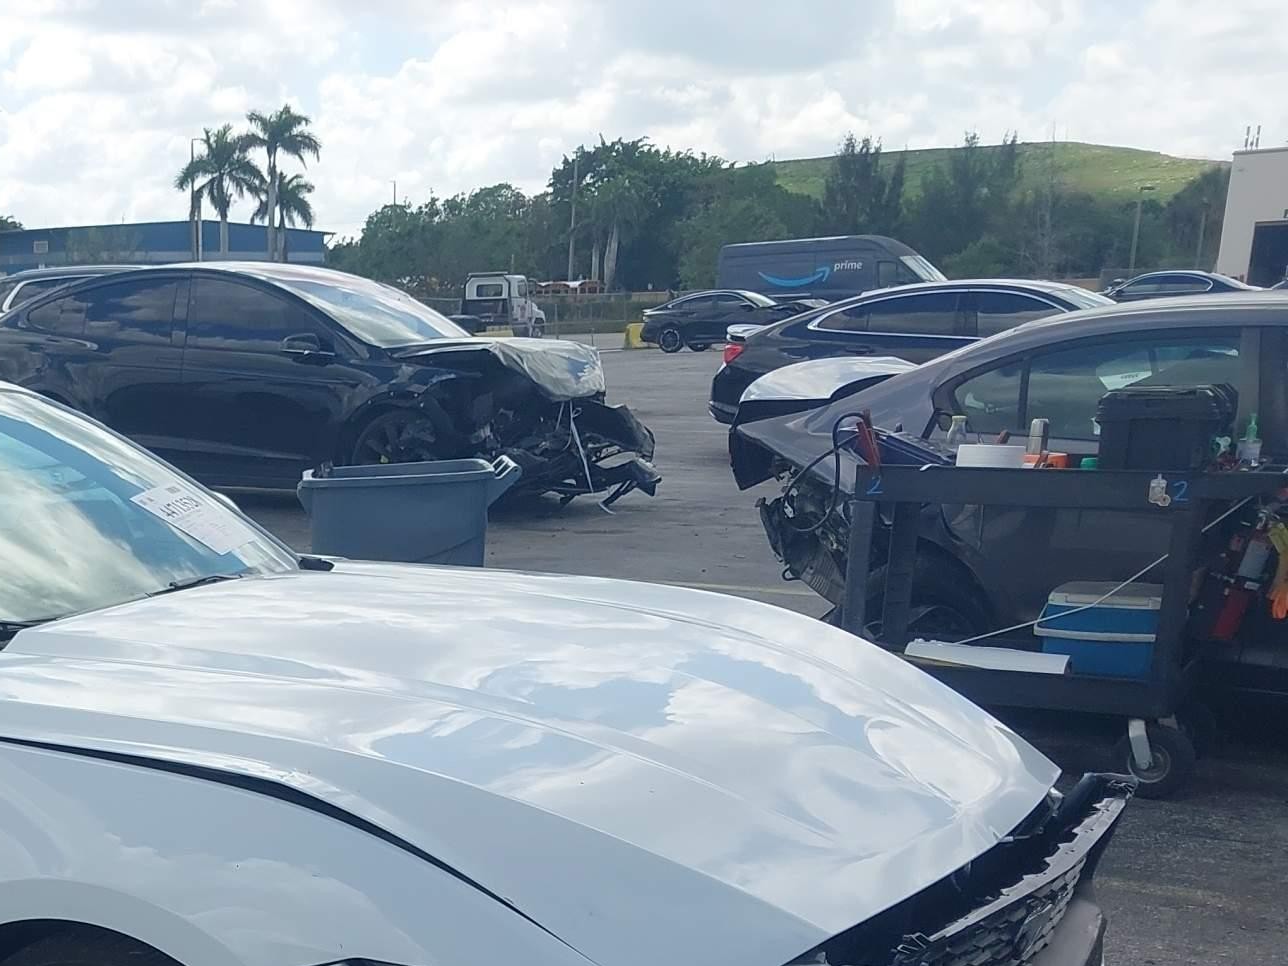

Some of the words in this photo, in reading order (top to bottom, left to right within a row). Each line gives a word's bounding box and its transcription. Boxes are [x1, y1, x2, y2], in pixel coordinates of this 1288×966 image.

[833, 260, 863, 272] prime
[866, 475, 883, 495] 2
[1173, 480, 1189, 501] 2
